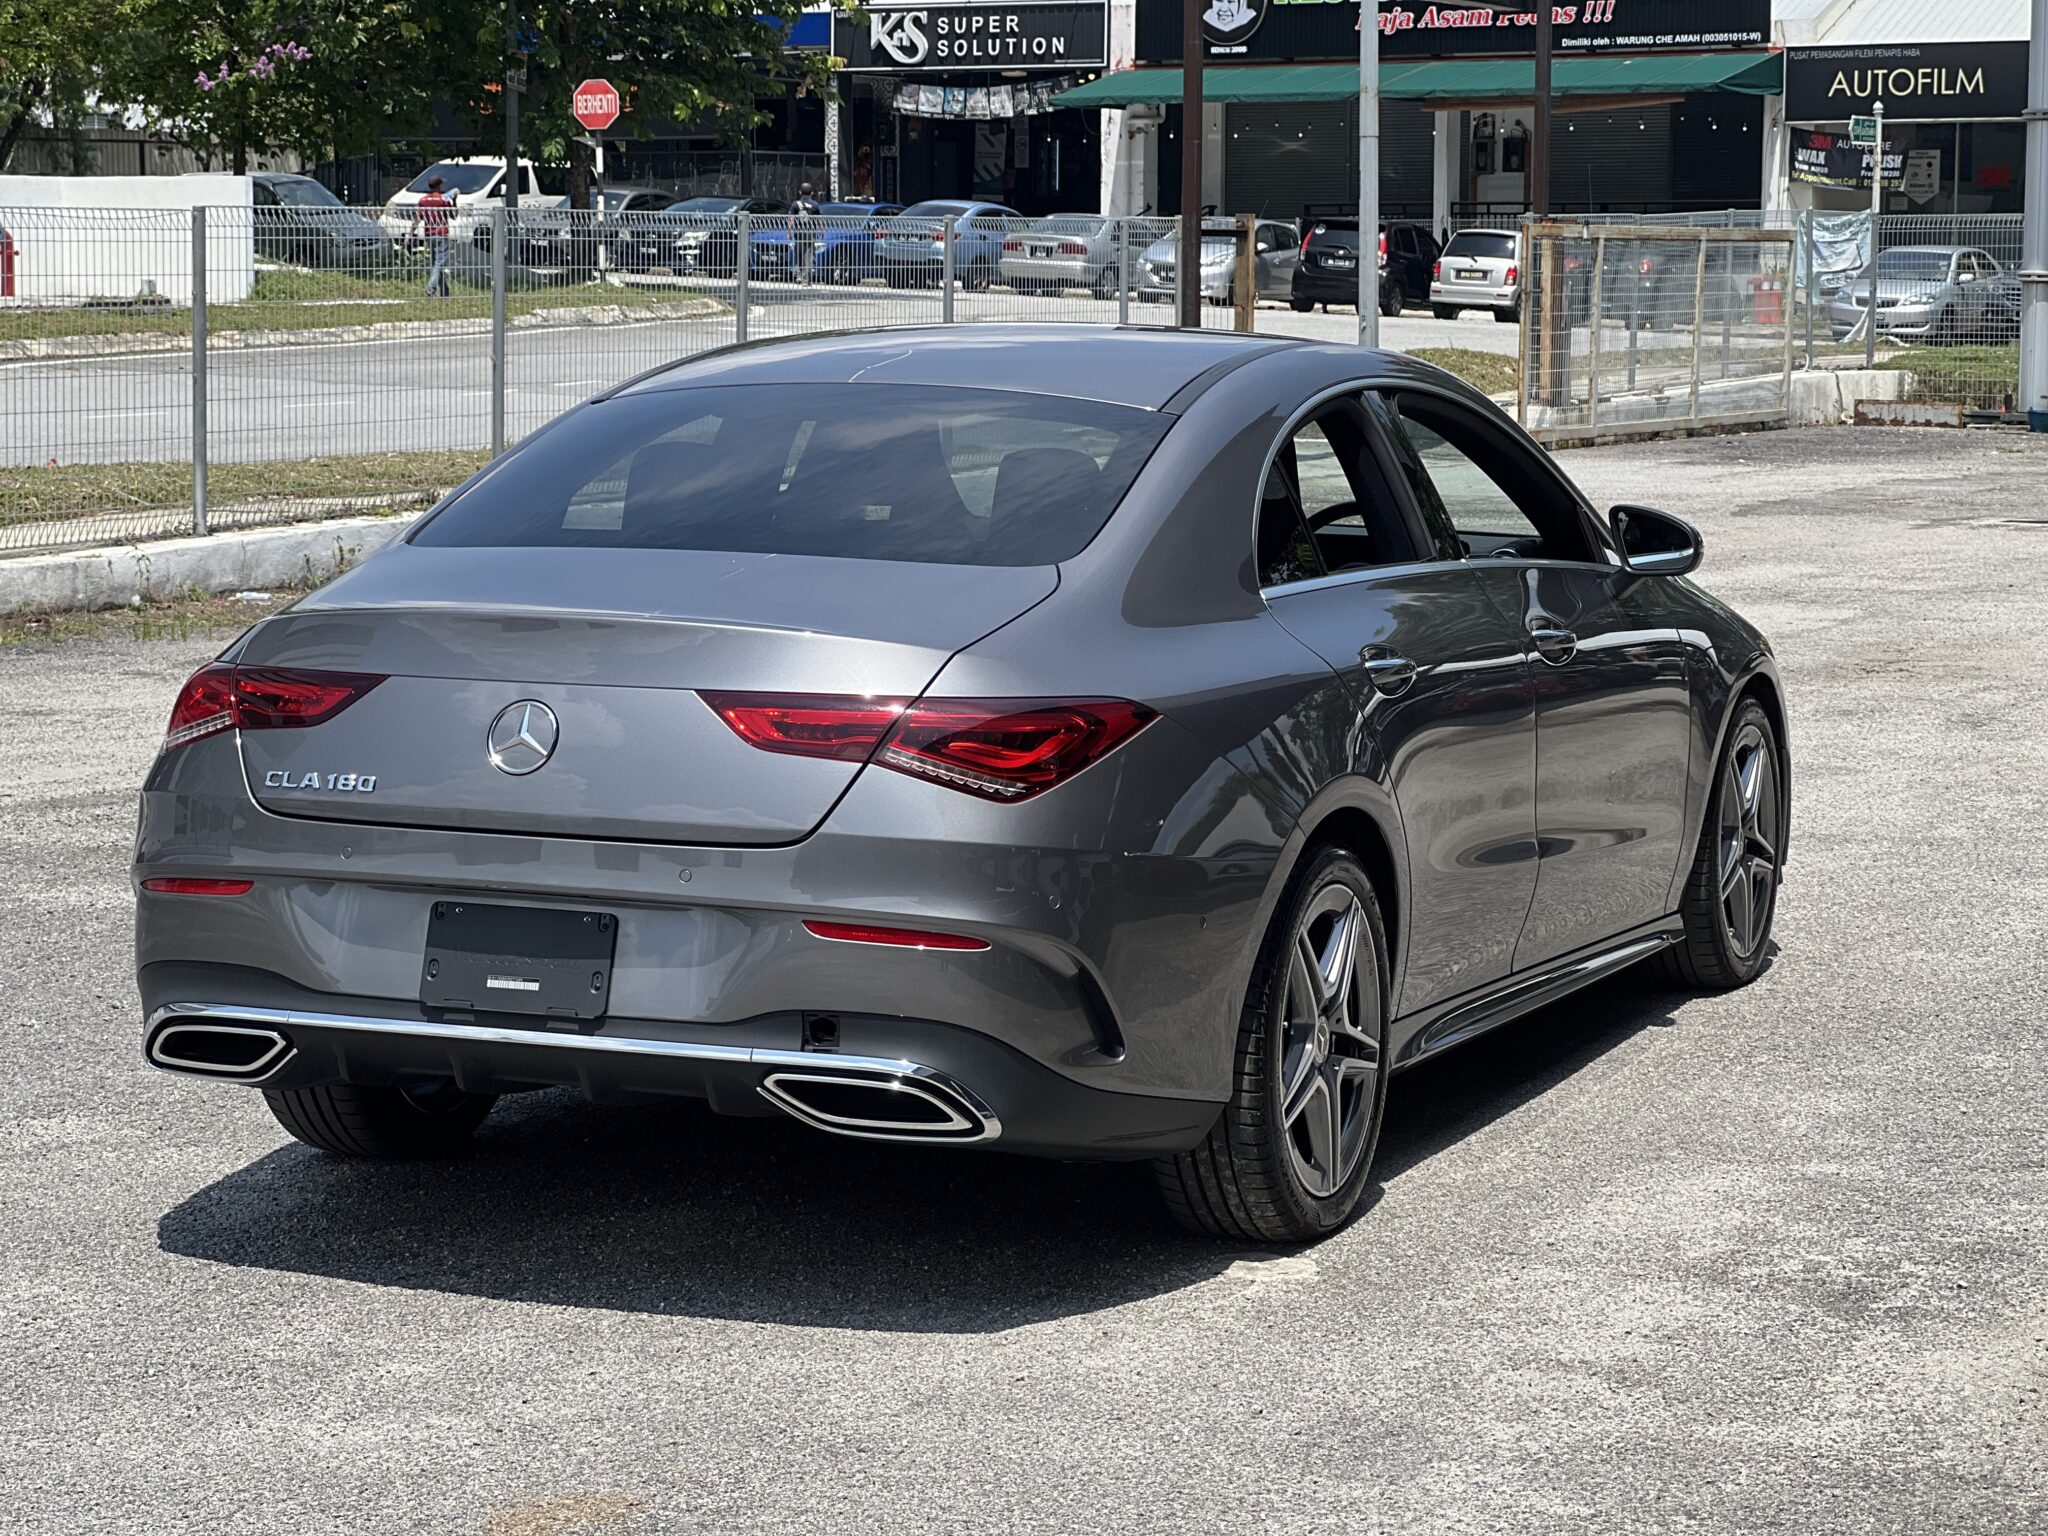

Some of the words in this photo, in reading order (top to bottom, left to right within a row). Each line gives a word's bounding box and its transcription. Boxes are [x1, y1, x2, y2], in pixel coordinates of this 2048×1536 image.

[937, 15, 1019, 34] SUPER
[1355, 6, 1414, 35] aja
[1417, 6, 1493, 28] Asam
[1582, 0, 1615, 23] !!!
[937, 37, 1065, 57] SOLUTION
[1562, 37, 1591, 47] Dimiliki
[1593, 36, 1610, 46] oleh
[1616, 35, 1654, 45] WARUNG
[1655, 34, 1673, 44] CHE
[1675, 33, 1700, 43] AMAH
[1701, 32, 1762, 43] (003051015-W)
[1789, 51, 1810, 60] PUSAT
[1810, 49, 1854, 59] PEMASANGAN
[1855, 49, 1873, 59] FILEM
[1874, 48, 1902, 58] PENAPIS
[1902, 48, 1920, 57] HABA
[1828, 67, 1985, 97] AUTOFILM
[577, 94, 616, 115] BERHENTI
[1809, 134, 1833, 149] 3M
[1797, 147, 1826, 165] WAX
[265, 770, 320, 789] CLA
[327, 773, 377, 792] 180
